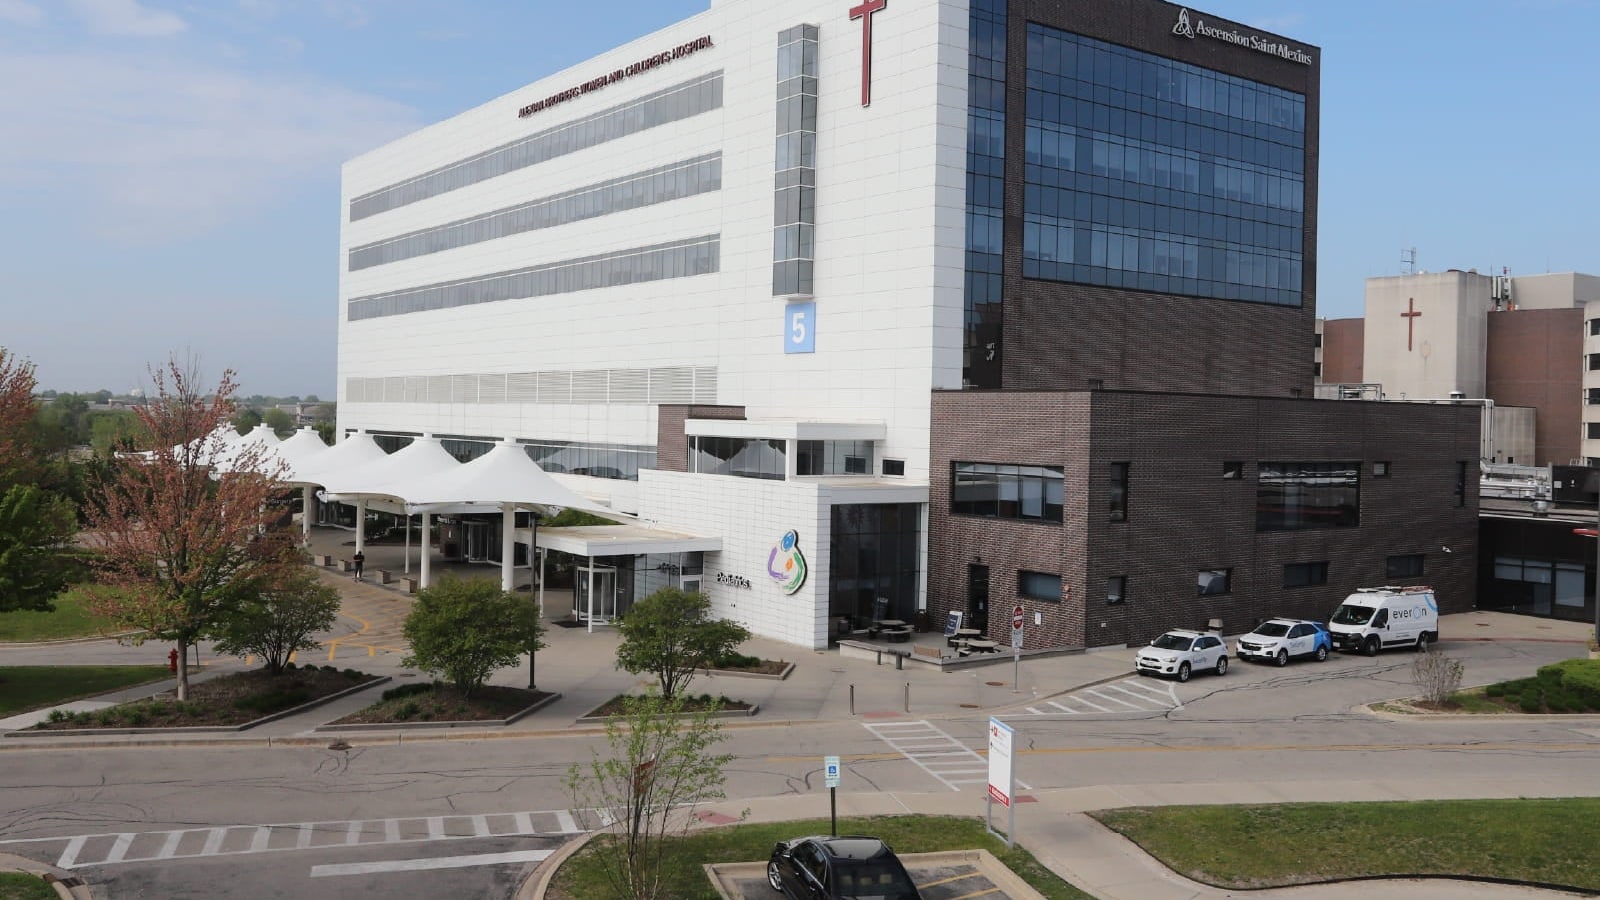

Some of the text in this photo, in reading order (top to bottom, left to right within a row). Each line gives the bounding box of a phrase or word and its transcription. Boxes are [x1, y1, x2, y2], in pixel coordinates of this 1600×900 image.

[580, 75, 608, 95] WOMEN
[608, 68, 625, 85] AND
[672, 35, 714, 60] HOSPITAL
[1196, 20, 1312, 66] Ascension Saint Alexius
[792, 312, 806, 344] 5
